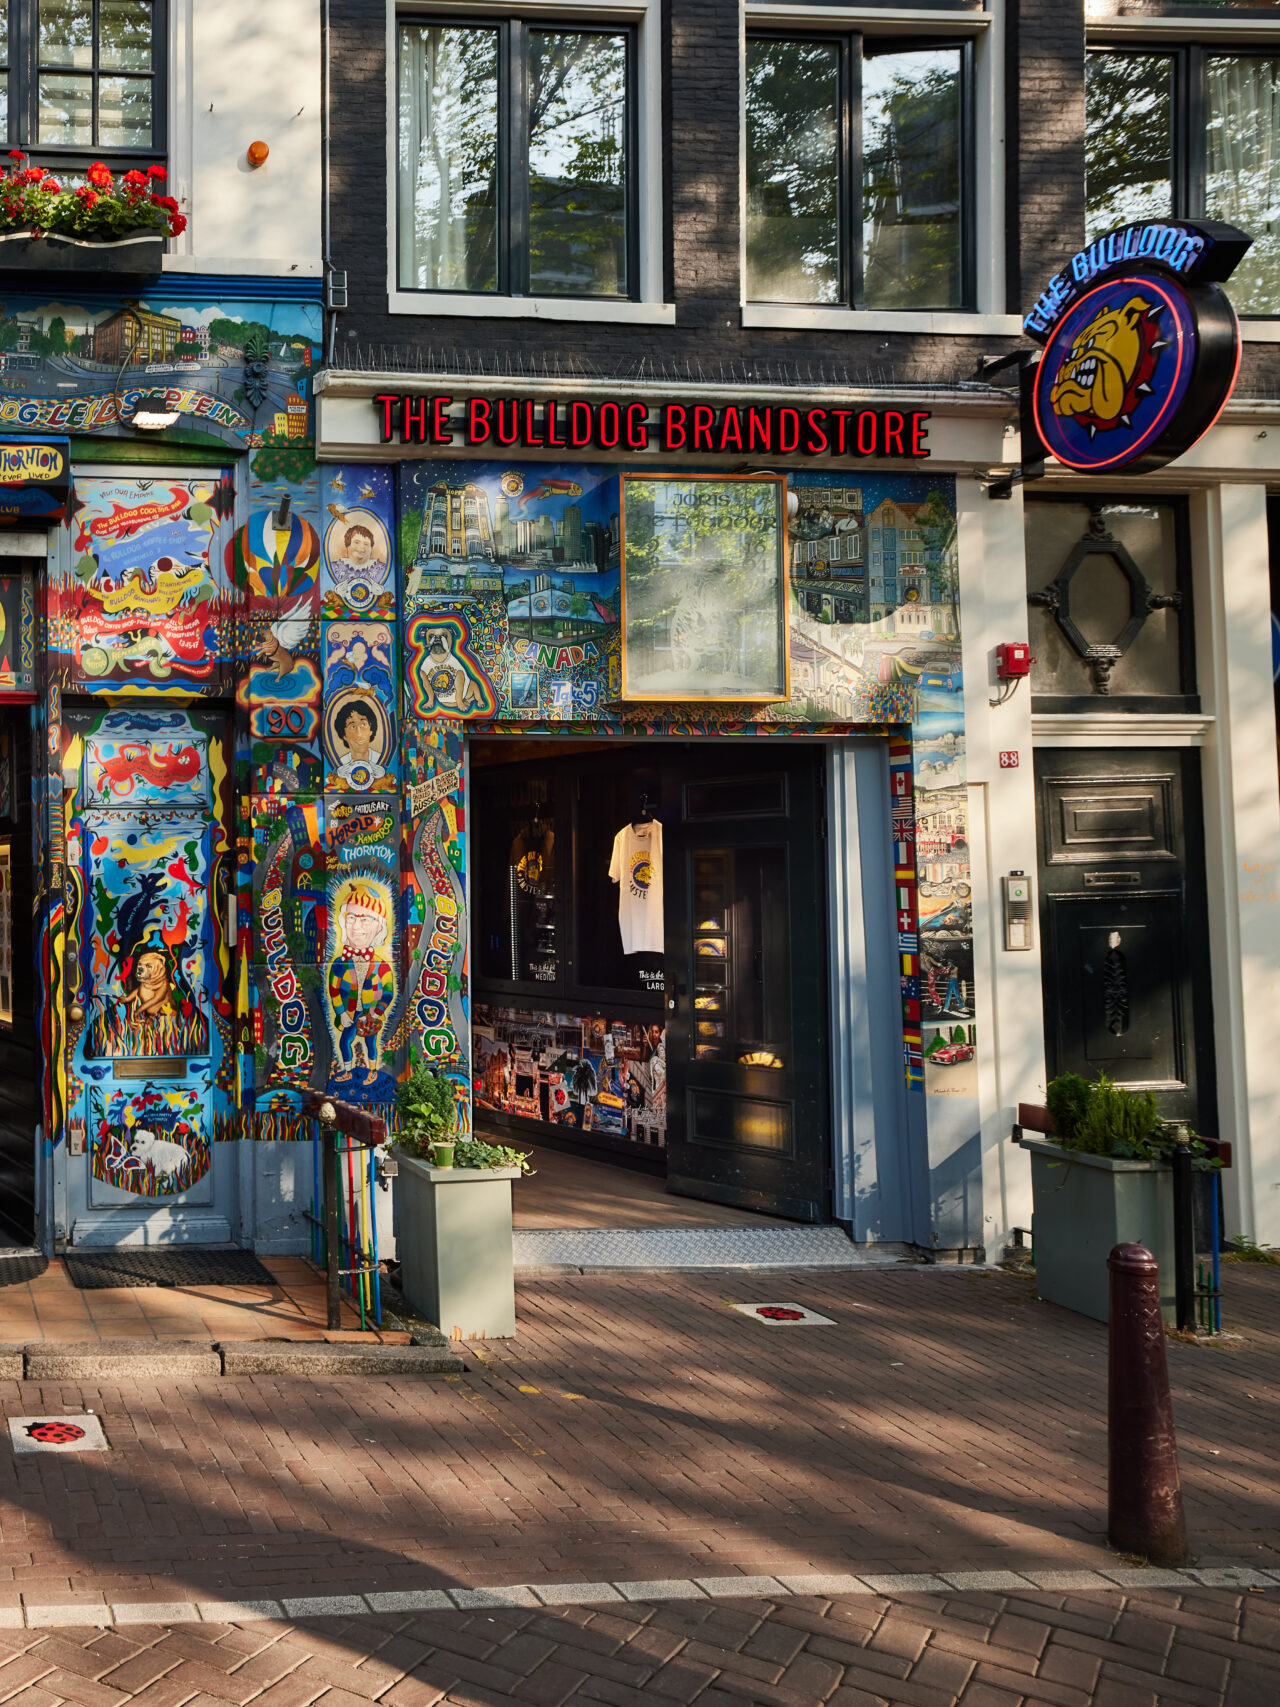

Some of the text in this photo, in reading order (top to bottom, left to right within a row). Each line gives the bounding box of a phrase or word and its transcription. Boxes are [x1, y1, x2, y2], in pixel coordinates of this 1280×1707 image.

[1072, 225, 1198, 281] BULLDOG
[1024, 275, 1071, 332] THE
[378, 394, 931, 456] THE BULLDOG BRANDSTORE
[28, 471, 51, 480] LIVED
[115, 488, 128, 496] OUR
[97, 500, 182, 530] The BULLDOG COCKTAIL BAR
[110, 588, 135, 605] BULLDOG
[81, 615, 105, 627] BULLDOG
[516, 638, 600, 670] CANADA
[551, 681, 598, 708] Take 5
[267, 707, 306, 733] 90
[1000, 752, 1018, 768] 88
[331, 801, 390, 818] WORLD FAMOUS ART
[329, 816, 375, 849] HAROLD
[330, 819, 338, 828] BY
[342, 845, 395, 863] THORNTON
[261, 887, 309, 1068] BULLDOG
[417, 894, 459, 1057] BULLDOG
[639, 970, 649, 979] This
[646, 982, 664, 990] LARG
